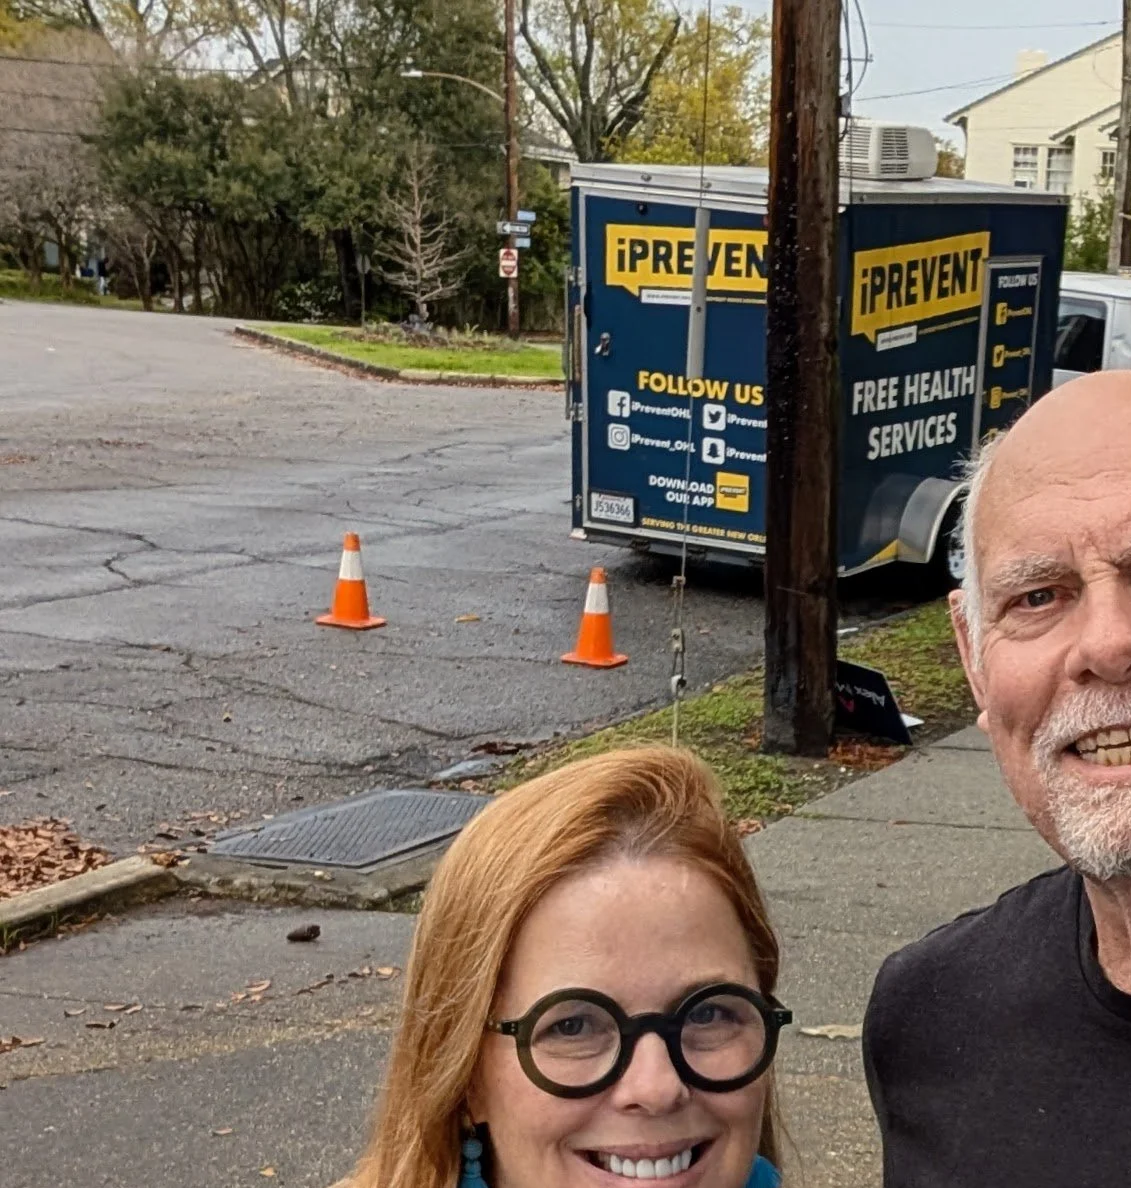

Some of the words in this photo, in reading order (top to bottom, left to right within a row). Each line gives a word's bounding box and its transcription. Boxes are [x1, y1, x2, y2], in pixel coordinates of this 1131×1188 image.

[617, 238, 768, 279] iPREVEN
[860, 248, 983, 315] iPREVENT
[638, 370, 729, 400] FOLLOW
[734, 383, 764, 406] US
[852, 376, 900, 415] FREE
[903, 364, 976, 407] HEALTH
[867, 411, 958, 460] SERVICES
[692, 495, 715, 508] APP
[641, 517, 675, 530] SERVING
[691, 524, 726, 537] GREATER
